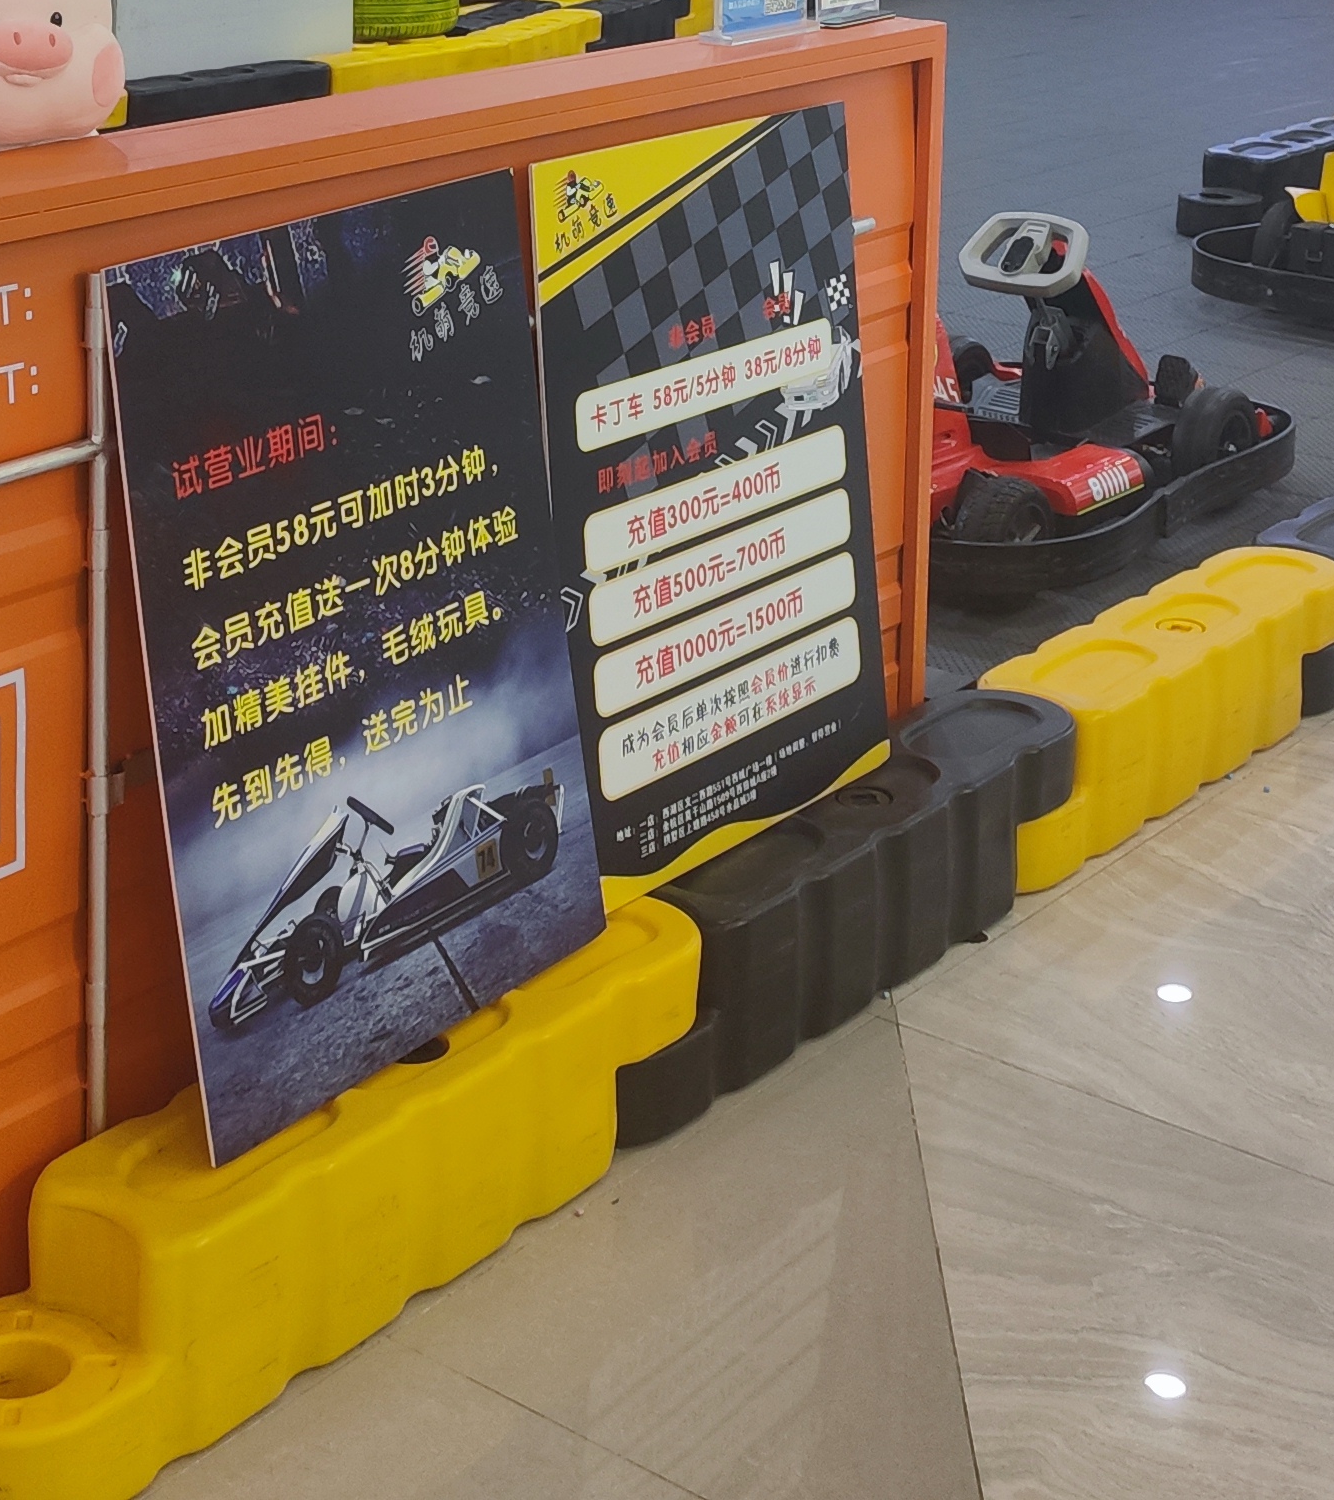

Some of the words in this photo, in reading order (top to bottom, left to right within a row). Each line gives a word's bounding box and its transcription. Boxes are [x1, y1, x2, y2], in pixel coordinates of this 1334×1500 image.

[590, 393, 645, 433] 卡丁车
[653, 362, 736, 411] 58元/5分钟
[744, 335, 822, 381] 38元/8分钟
[626, 465, 781, 549] 充值300元=400币
[191, 506, 519, 671] 会员充值送一次8分钟体验
[632, 527, 786, 618] 充值500元=700币
[635, 586, 804, 689] 充值1000元=1500币
[622, 637, 840, 758] 成为会员后单次按照会员价进行扣费
[652, 676, 817, 772] 充值相应金额可在系统显示
